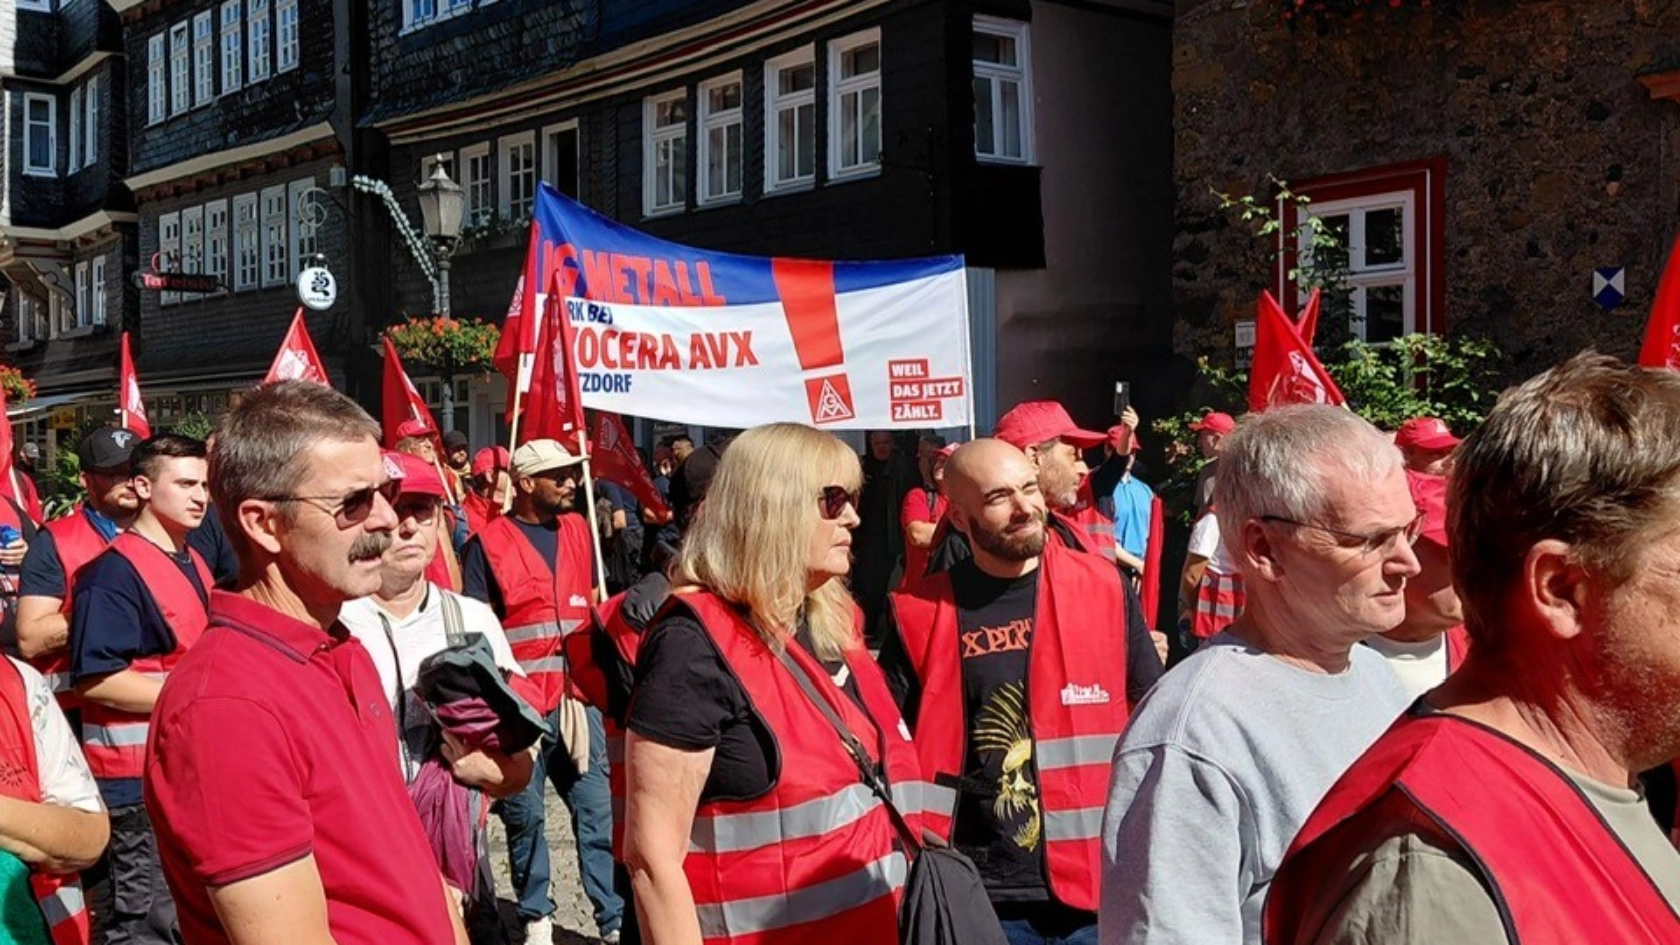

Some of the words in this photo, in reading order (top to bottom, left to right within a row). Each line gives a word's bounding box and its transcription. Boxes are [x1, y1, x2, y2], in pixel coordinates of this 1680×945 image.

[582, 249, 726, 307] METALL
[689, 331, 759, 370] AVX
[891, 363, 925, 378] WEIL
[893, 384, 920, 399] DAS
[921, 381, 961, 400] JETZT
[894, 403, 939, 420] ZÄHLT.
